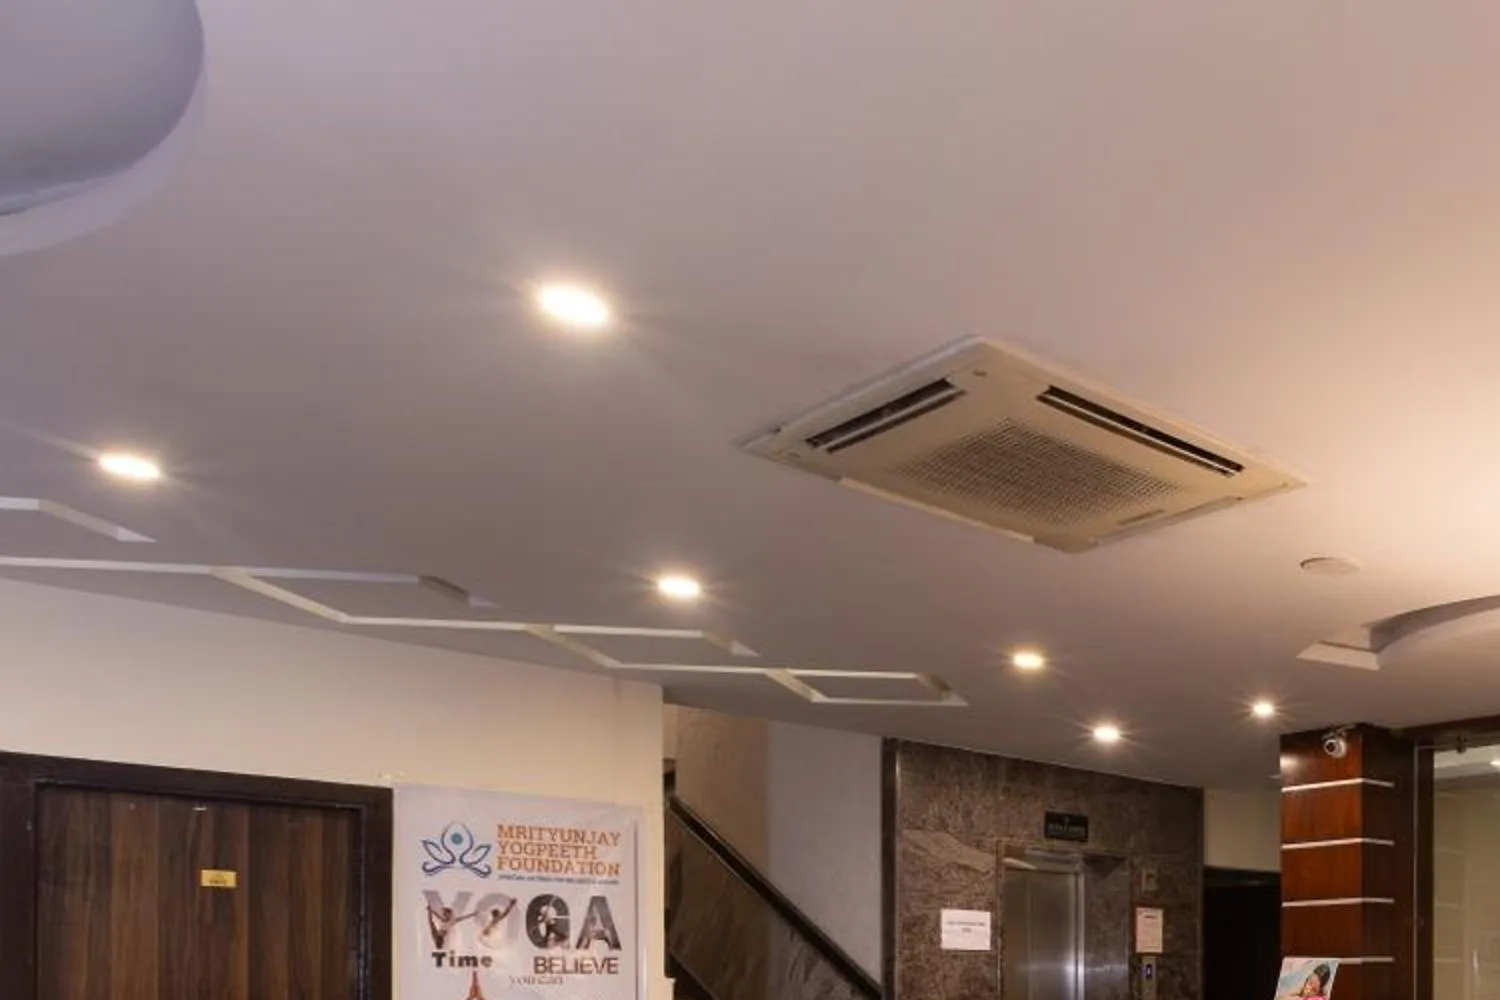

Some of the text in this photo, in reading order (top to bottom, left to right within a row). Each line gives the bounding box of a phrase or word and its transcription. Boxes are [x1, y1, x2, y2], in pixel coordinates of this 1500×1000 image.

[496, 823, 622, 847] MRITYUNJAY
[496, 840, 598, 860] YOGPEETH
[496, 855, 620, 876] FOUNDATION
[431, 951, 493, 968] Time
[533, 955, 619, 975] BELIEVE
